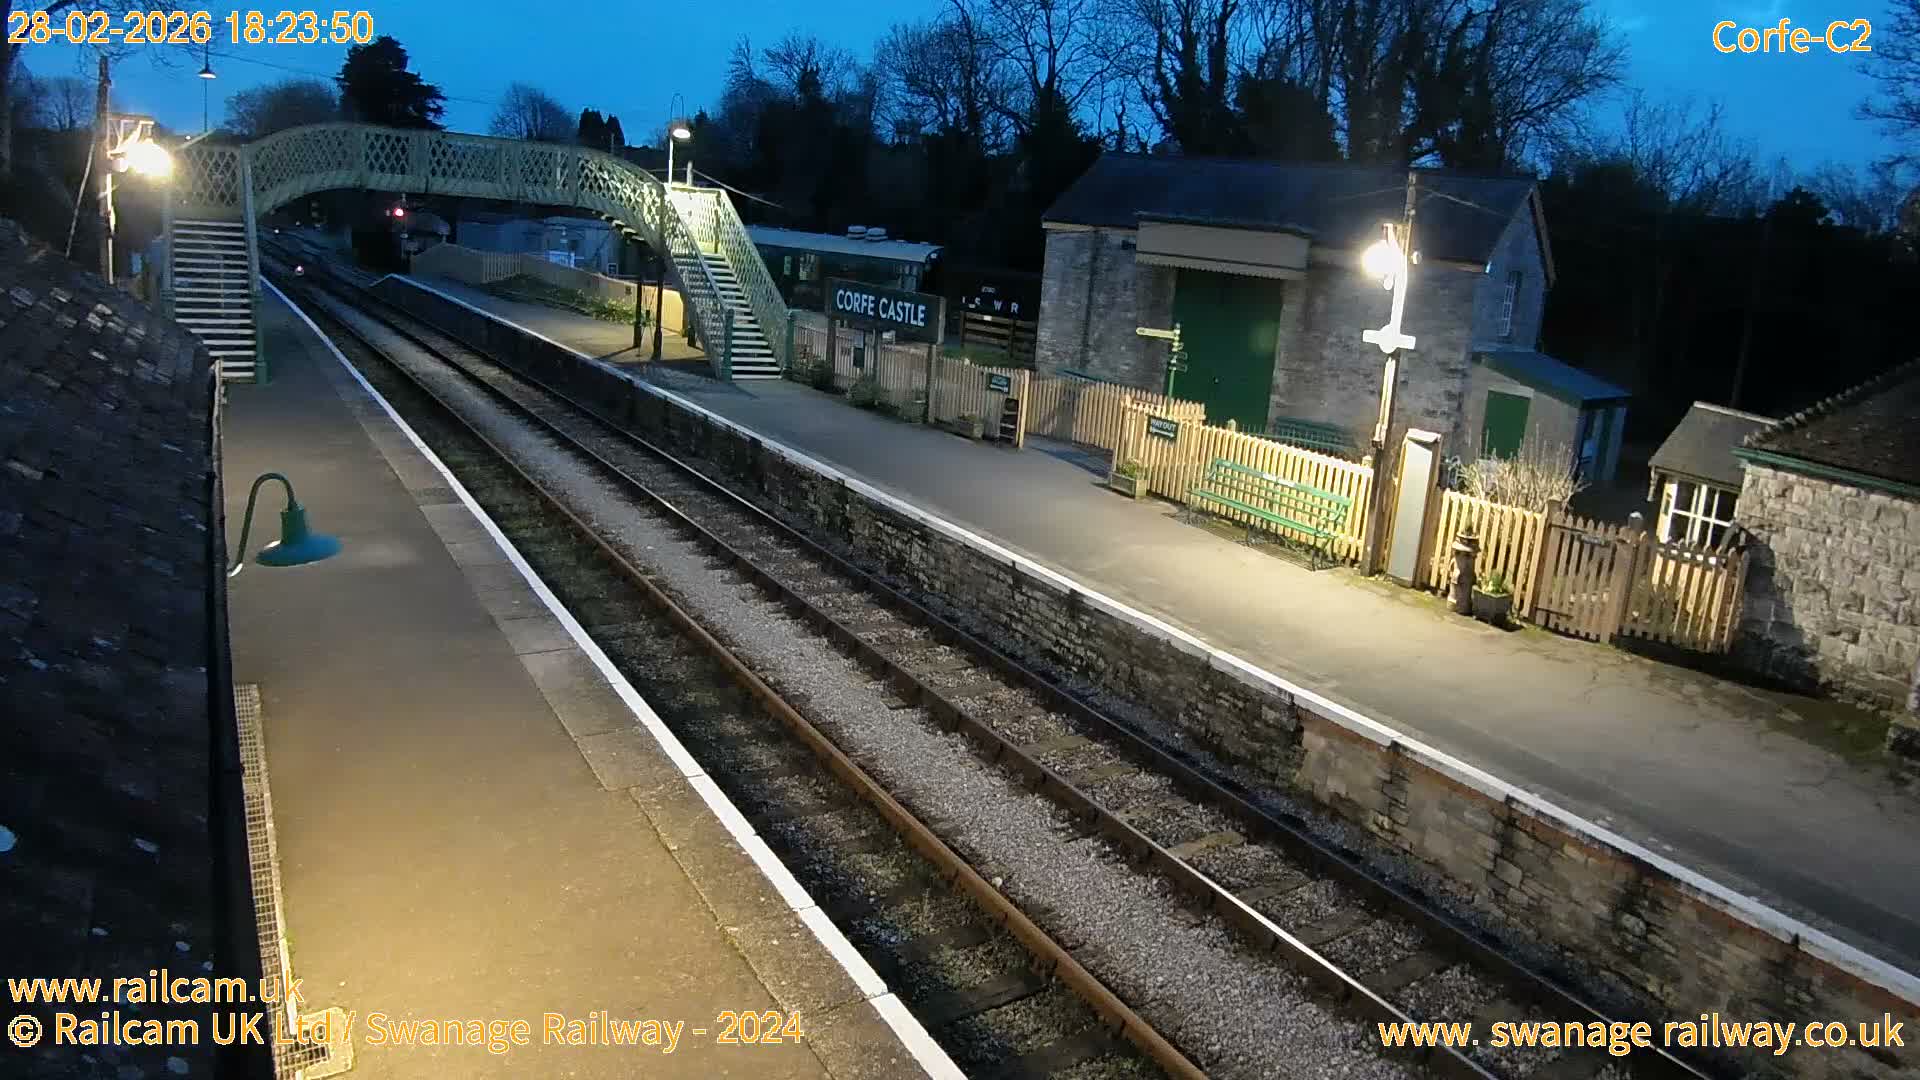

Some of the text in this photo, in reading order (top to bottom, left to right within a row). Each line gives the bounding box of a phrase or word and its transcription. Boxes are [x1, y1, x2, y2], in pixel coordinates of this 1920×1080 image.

[836, 289, 926, 327] CORFE CASTLE
[1162, 421, 1177, 432] OUT
